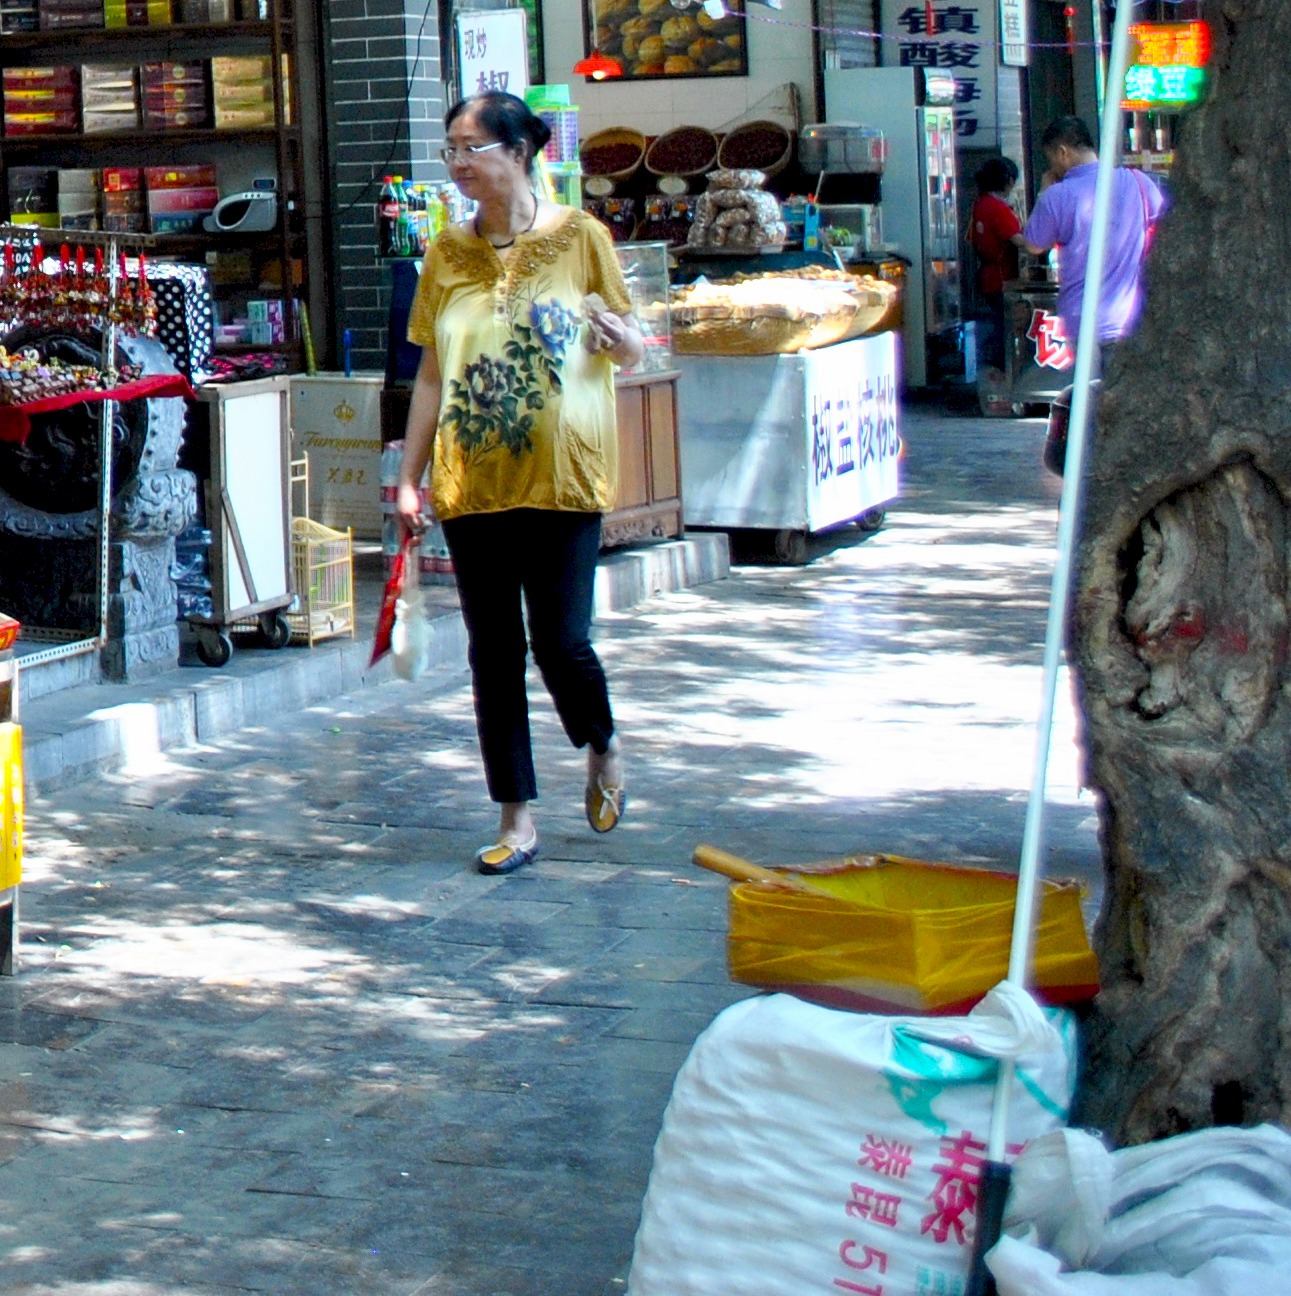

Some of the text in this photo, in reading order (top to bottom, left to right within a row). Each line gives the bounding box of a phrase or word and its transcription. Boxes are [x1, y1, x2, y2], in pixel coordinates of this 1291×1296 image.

[463, 26, 488, 57] 现炒
[811, 374, 897, 488] 椒盐核桃
[844, 1132, 912, 1228] 泰昆
